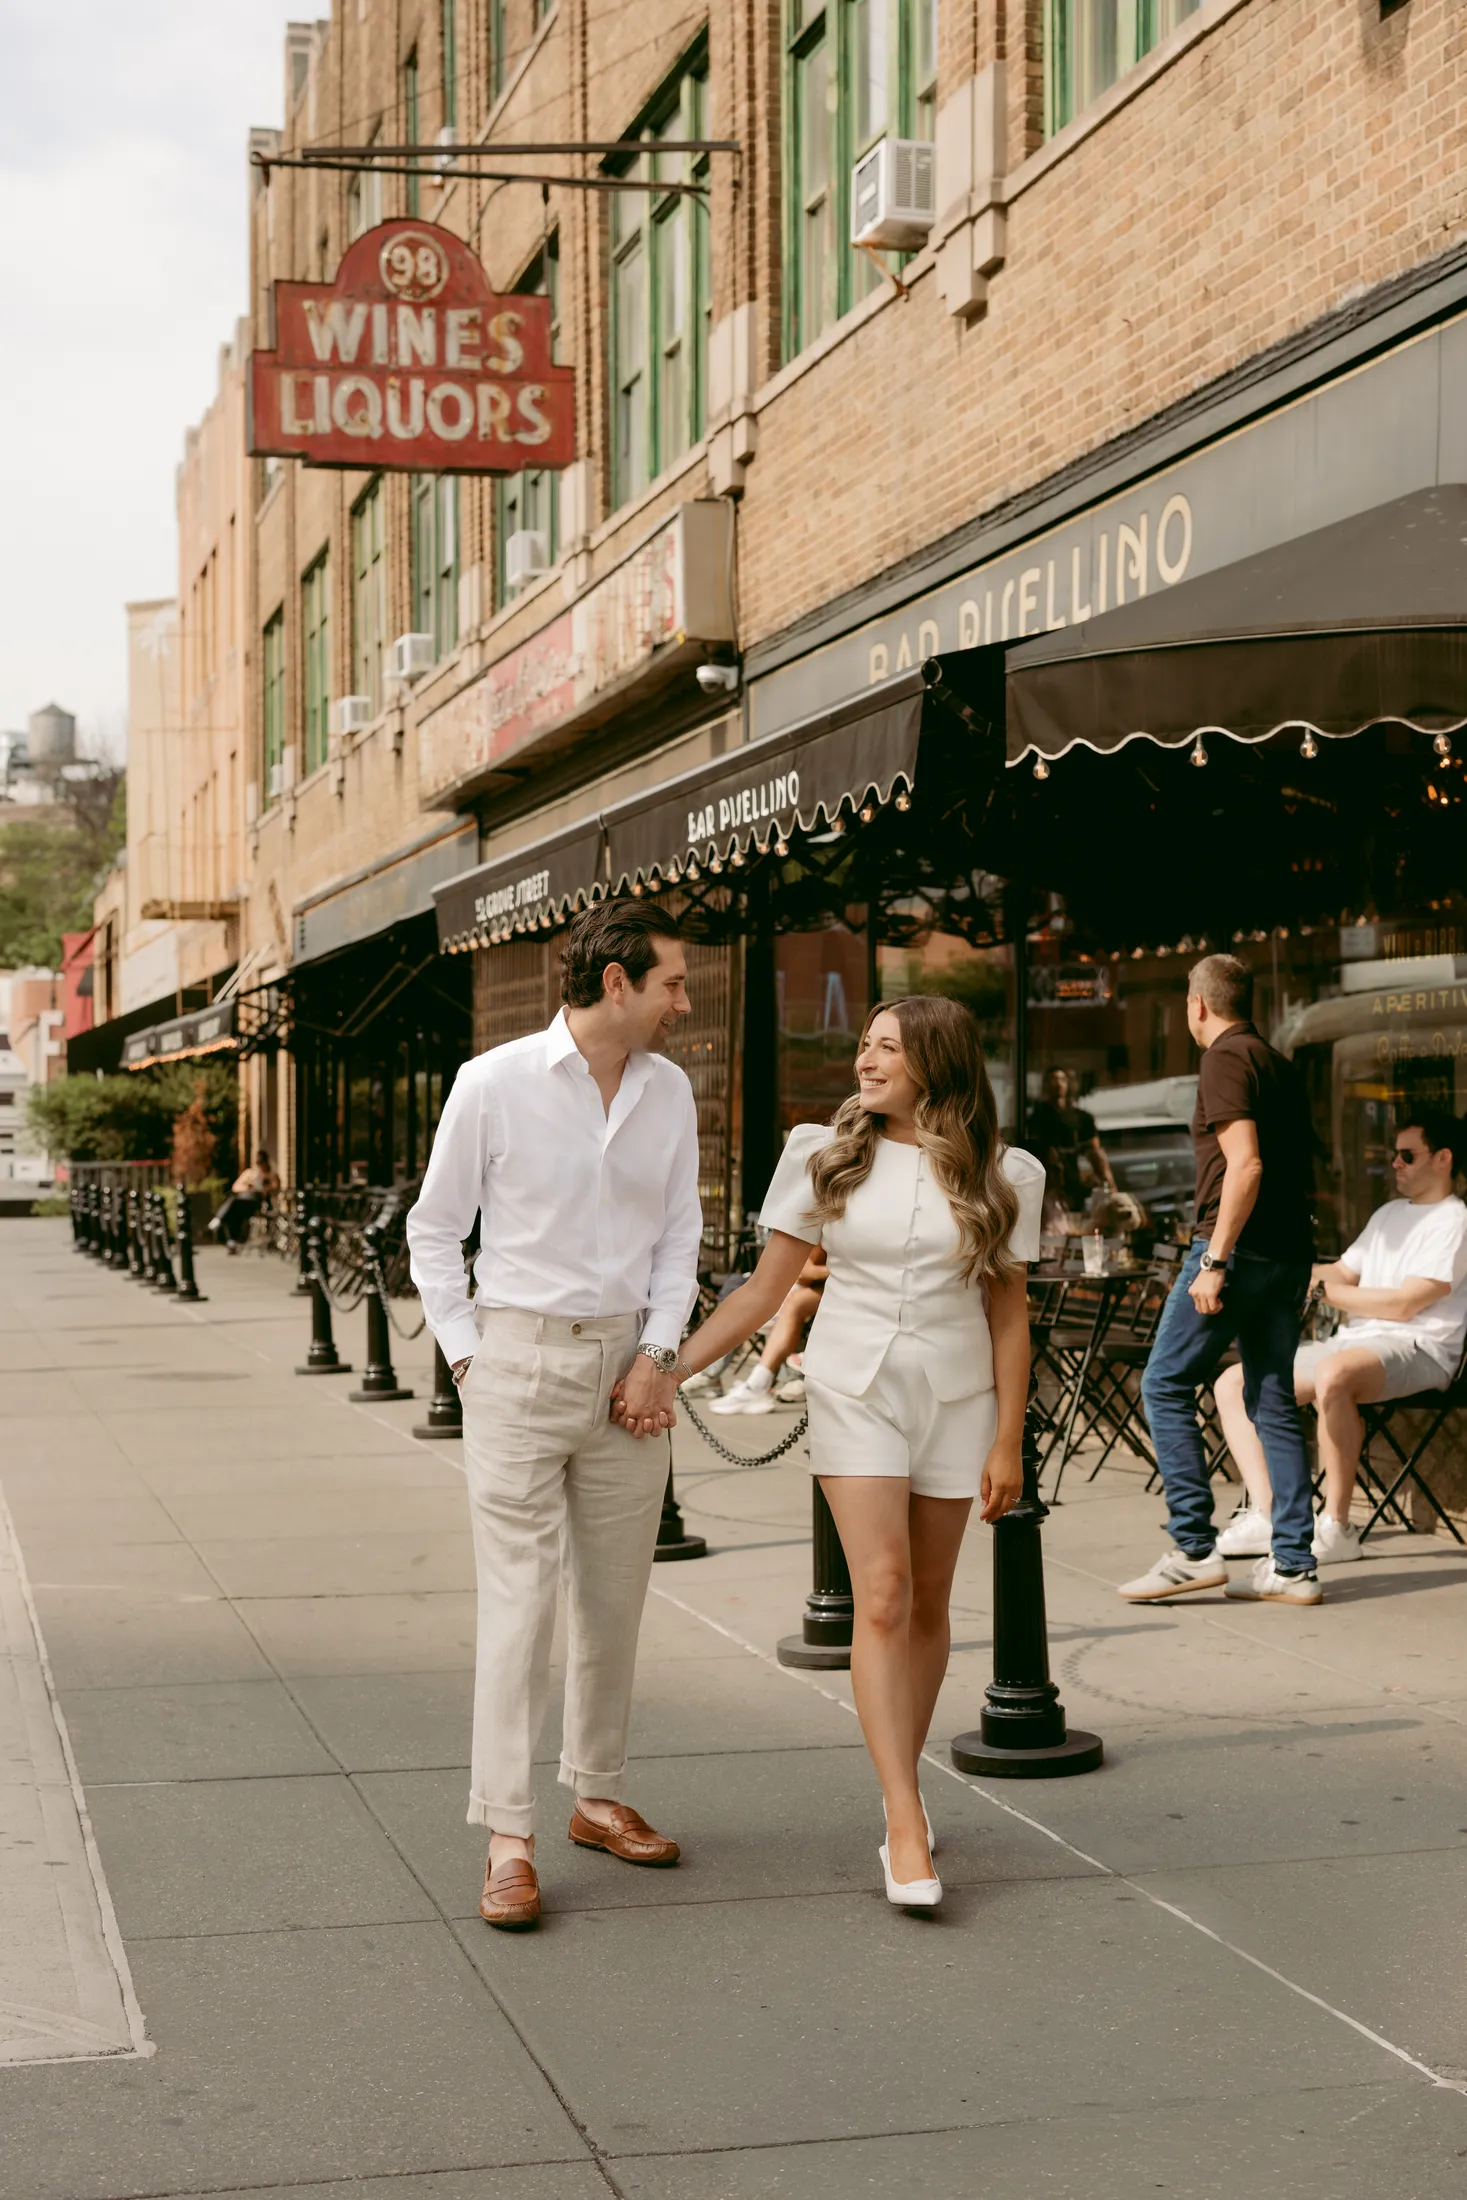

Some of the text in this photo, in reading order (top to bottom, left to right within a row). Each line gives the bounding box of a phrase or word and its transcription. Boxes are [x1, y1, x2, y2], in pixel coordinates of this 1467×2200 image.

[389, 245, 440, 286] 98
[302, 299, 524, 374] WINES
[280, 372, 551, 445] LIQUORS
[515, 869, 550, 908] STREET
